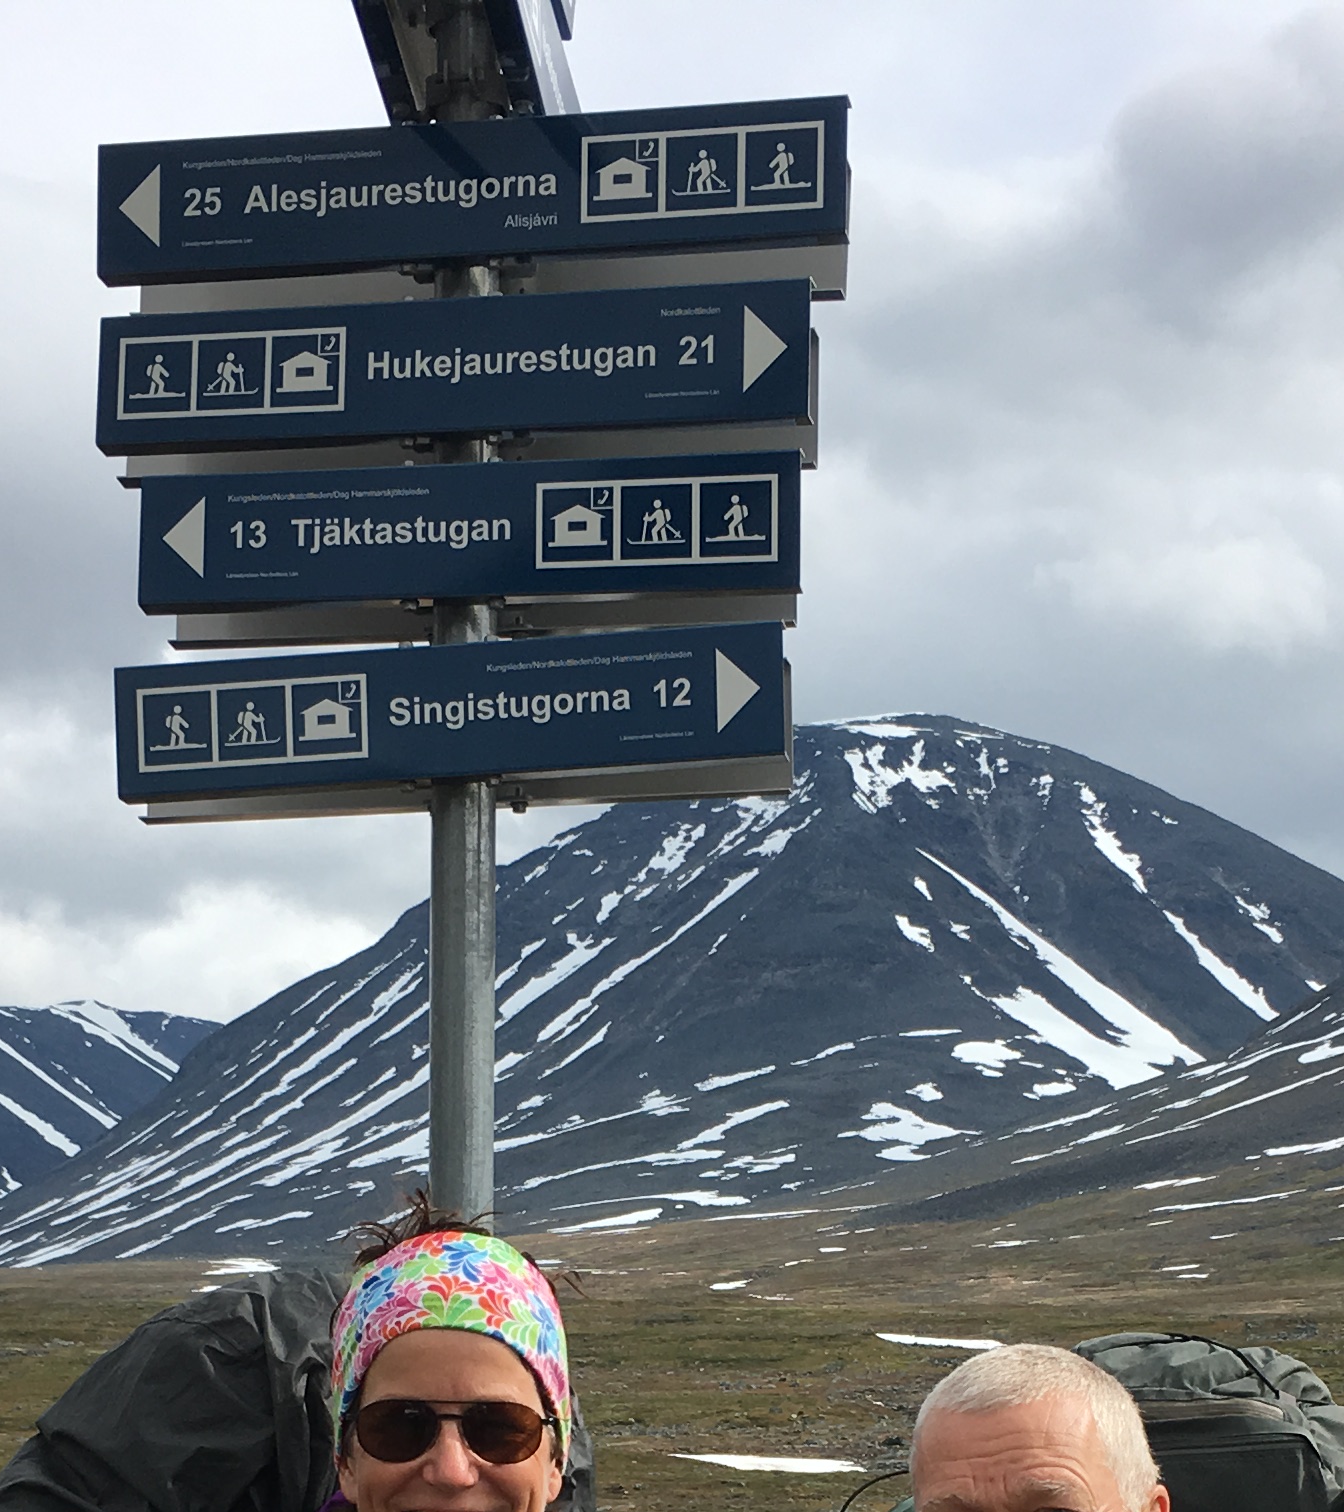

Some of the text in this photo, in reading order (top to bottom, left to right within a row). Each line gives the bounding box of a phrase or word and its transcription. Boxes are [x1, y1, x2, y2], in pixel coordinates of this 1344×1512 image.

[183, 173, 557, 217] 25 Alesjaurestugorna
[504, 212, 558, 230] Alisjávri
[367, 334, 715, 384] Hukejaurestugan 21
[229, 515, 512, 554] 13 Tjäktastugan
[389, 677, 693, 730] Singistugorna 12
